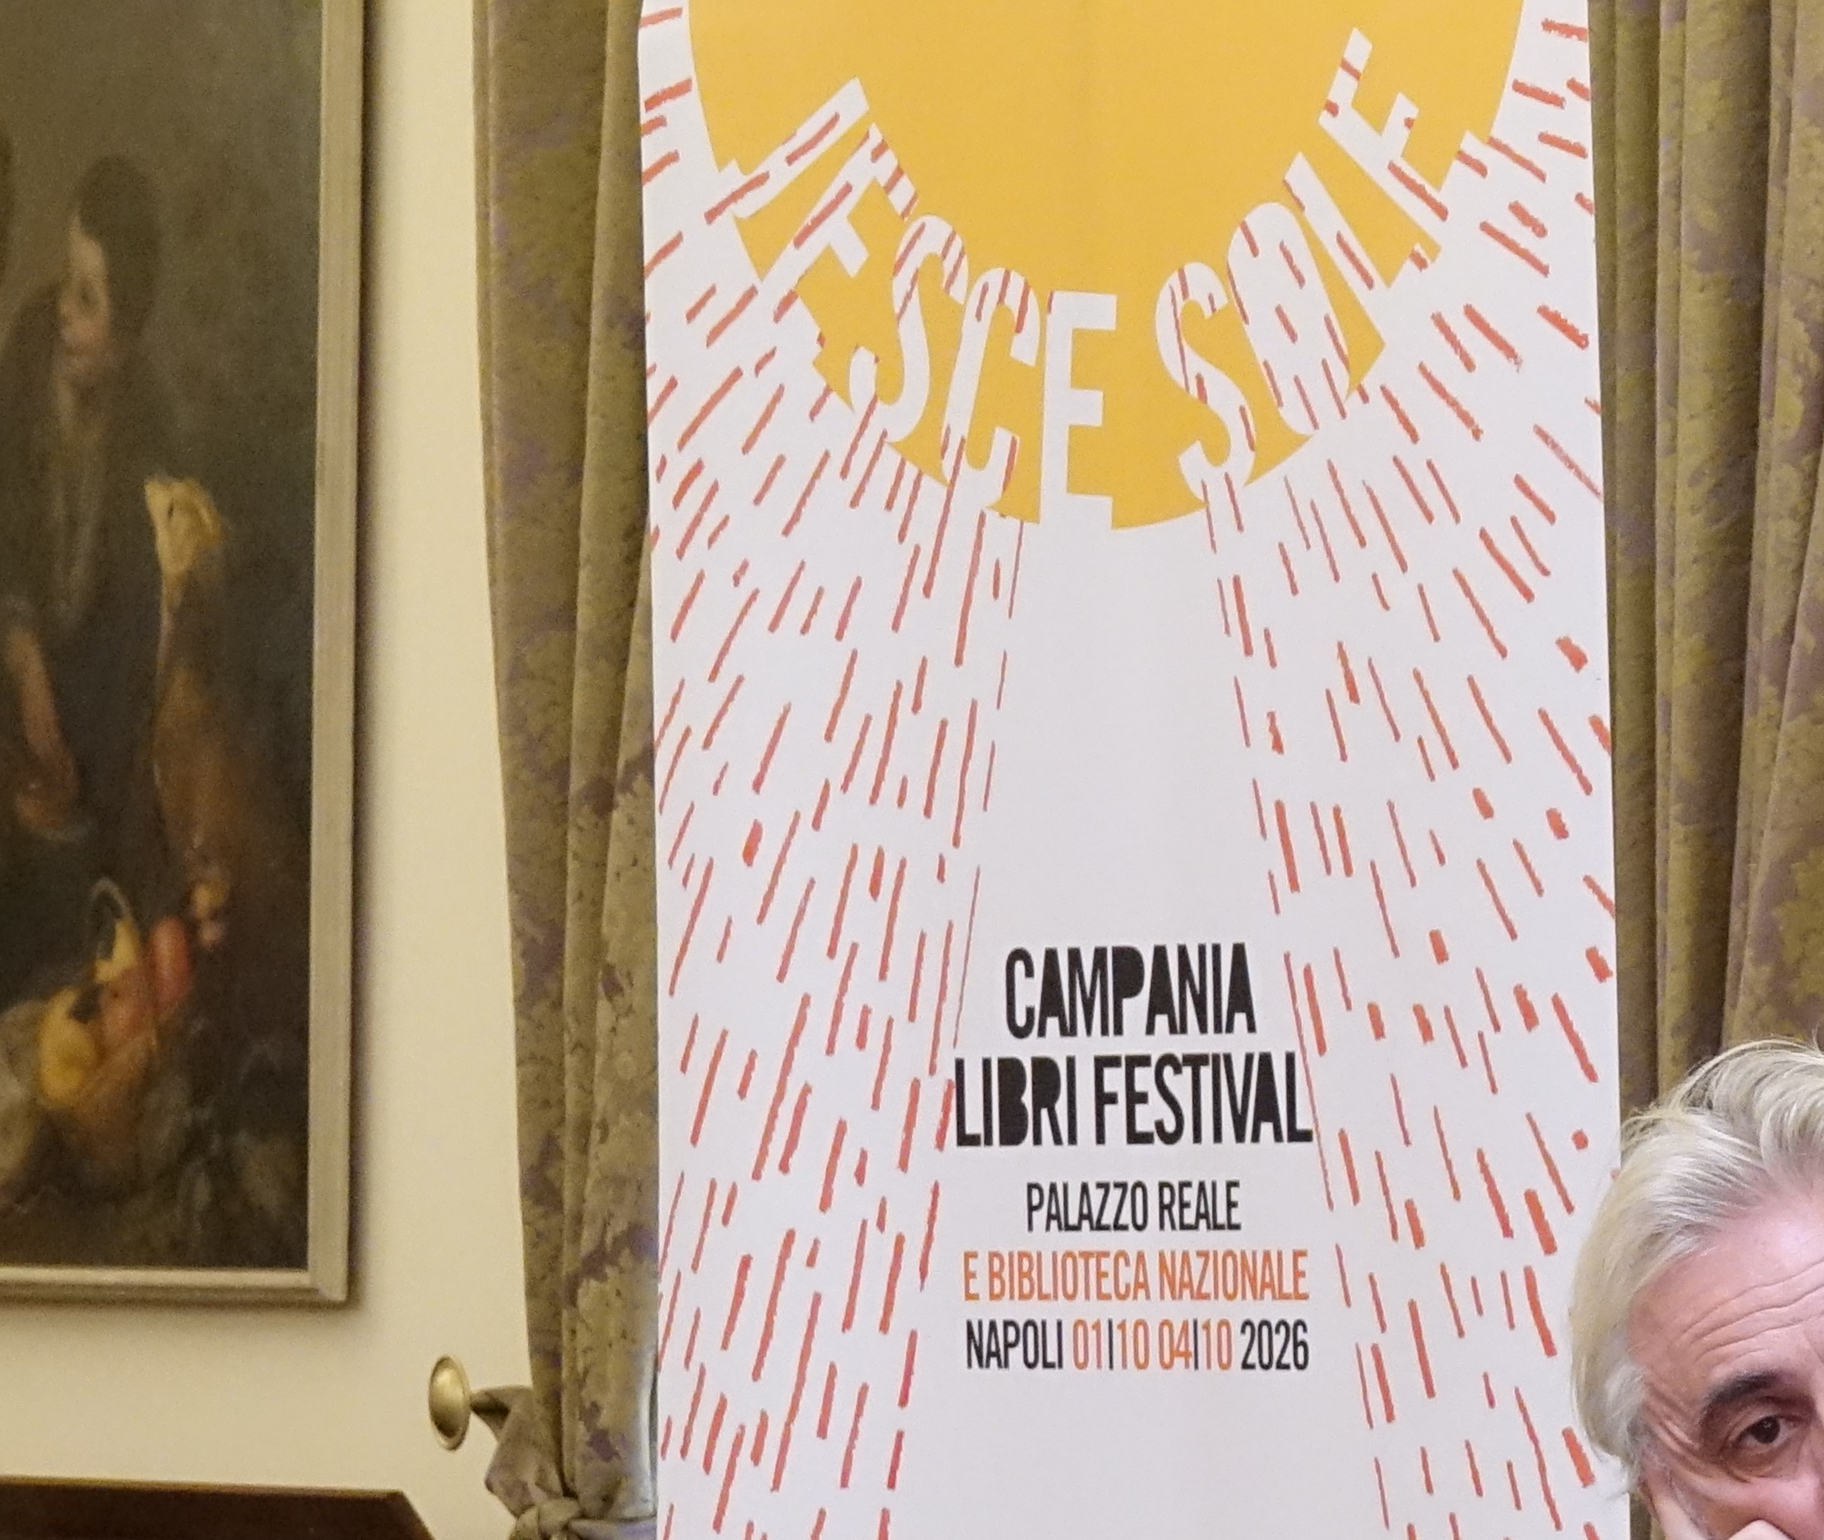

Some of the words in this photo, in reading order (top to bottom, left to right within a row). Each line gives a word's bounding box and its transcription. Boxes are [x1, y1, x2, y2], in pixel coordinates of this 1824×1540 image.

[1005, 942, 1257, 1040] CAMPANIA
[954, 1055, 1078, 1147] LIBRI
[1094, 1051, 1314, 1145] FESTIVAL
[1026, 1181, 1149, 1232] PALAZZO
[1158, 1180, 1242, 1232] REALE
[963, 1250, 980, 1301] E
[987, 1250, 1151, 1302] BIBLIOTECA
[1158, 1249, 1310, 1302] NAZIONALE
[966, 1319, 1064, 1370] NAPOLI
[1240, 1319, 1310, 1371] 2026
